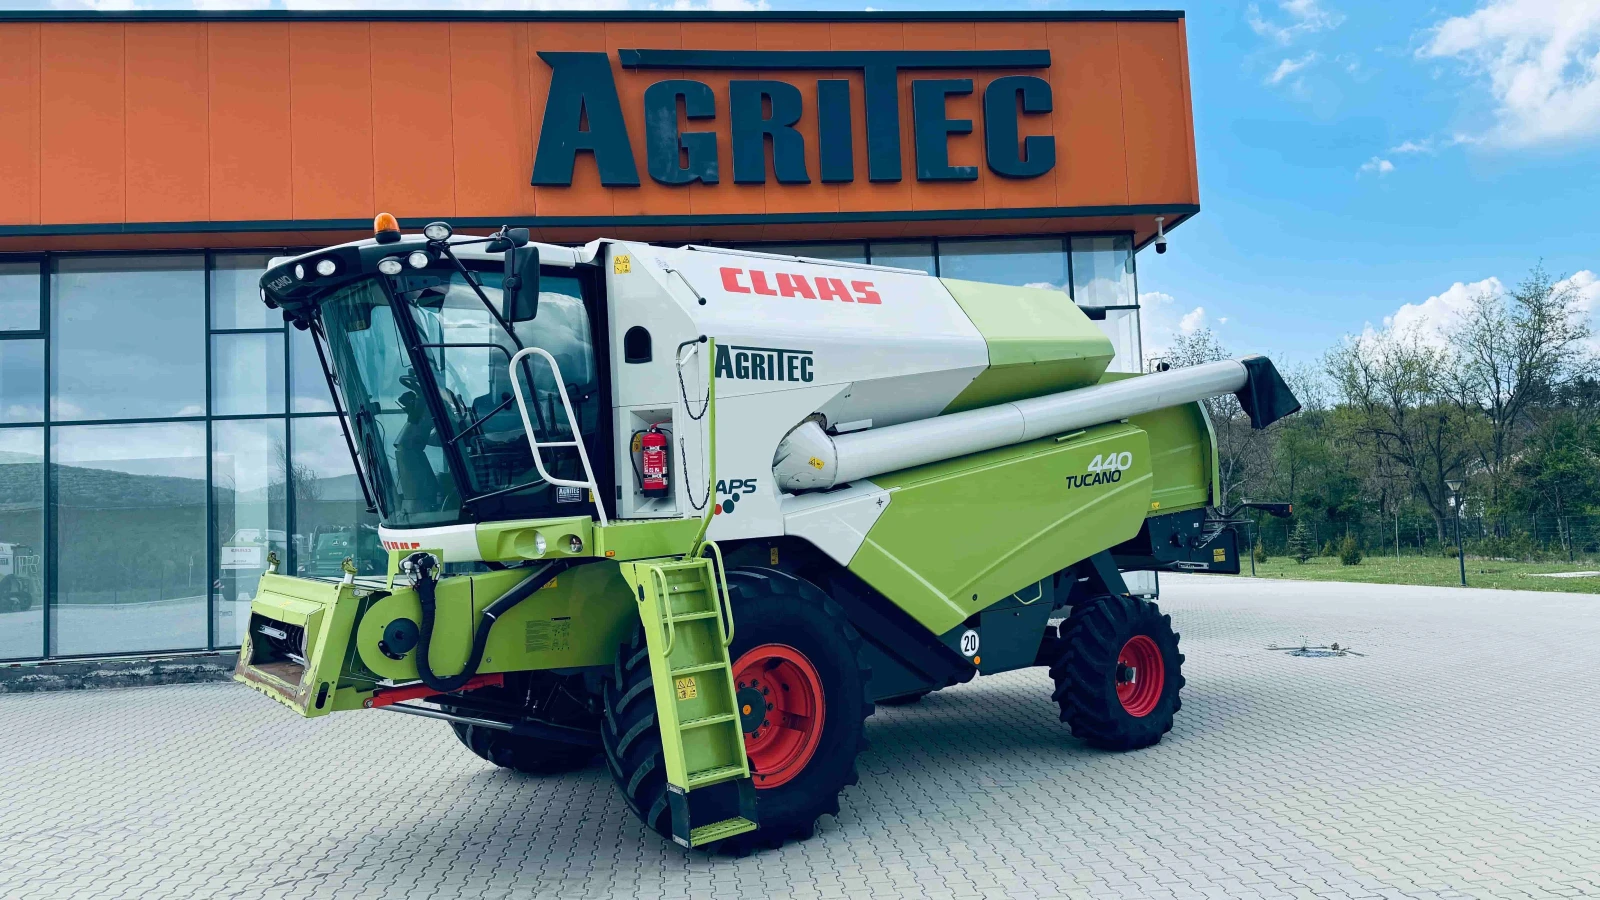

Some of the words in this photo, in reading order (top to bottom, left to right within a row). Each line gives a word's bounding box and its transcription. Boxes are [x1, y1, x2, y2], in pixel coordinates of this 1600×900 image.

[719, 266, 882, 304] CLAAS
[1088, 451, 1132, 472] 440
[715, 479, 757, 494] APS
[1065, 470, 1121, 489] TUCANO
[964, 634, 976, 652] 20
